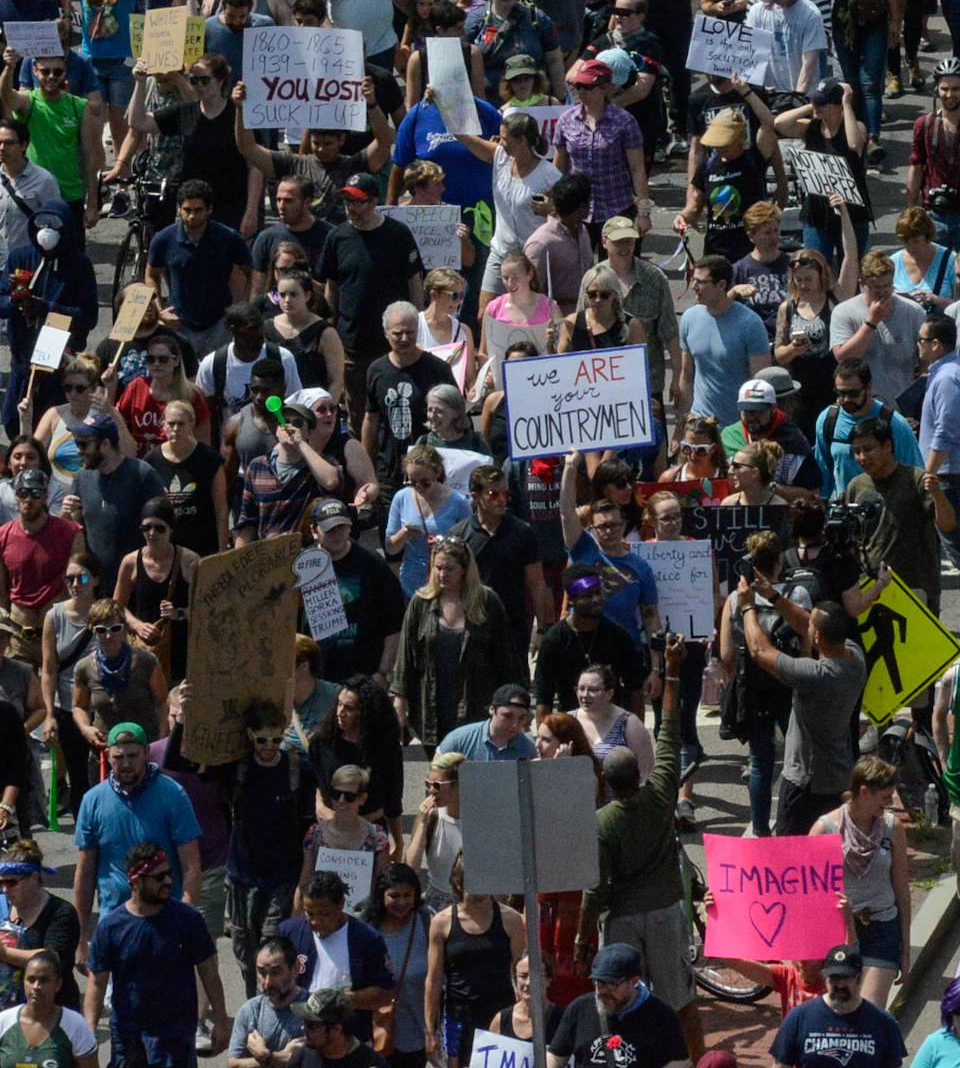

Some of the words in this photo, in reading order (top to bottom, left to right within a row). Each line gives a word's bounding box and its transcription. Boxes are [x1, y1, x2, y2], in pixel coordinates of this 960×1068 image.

[701, 17, 753, 42] LOVE
[252, 32, 290, 50] 1860
[306, 34, 345, 54] 1865
[738, 43, 756, 59] only
[147, 47, 180, 68] LIVES
[251, 54, 289, 73] 1939
[311, 56, 355, 76] 1945
[261, 75, 310, 101] YOU
[251, 103, 300, 126] SUCK
[308, 103, 328, 123] IT
[335, 105, 361, 125] UP
[788, 148, 816, 170] NOT
[816, 152, 851, 178] MEIN
[406, 207, 460, 224] SPEECH
[526, 368, 561, 387] we
[574, 354, 626, 387] ARE
[550, 386, 601, 412] your
[513, 398, 647, 452] COUNTRYMEN
[527, 483, 546, 491] MIND
[528, 501, 546, 510] SOUL
[692, 507, 770, 532] STILL
[296, 559, 323, 571] #FIRE
[305, 588, 336, 606] MILLER
[311, 615, 346, 636] TRUMP
[320, 855, 368, 868] CONSIDER
[719, 859, 845, 896] IMAGINE
[803, 1038, 876, 1056] CHAMPIONS
